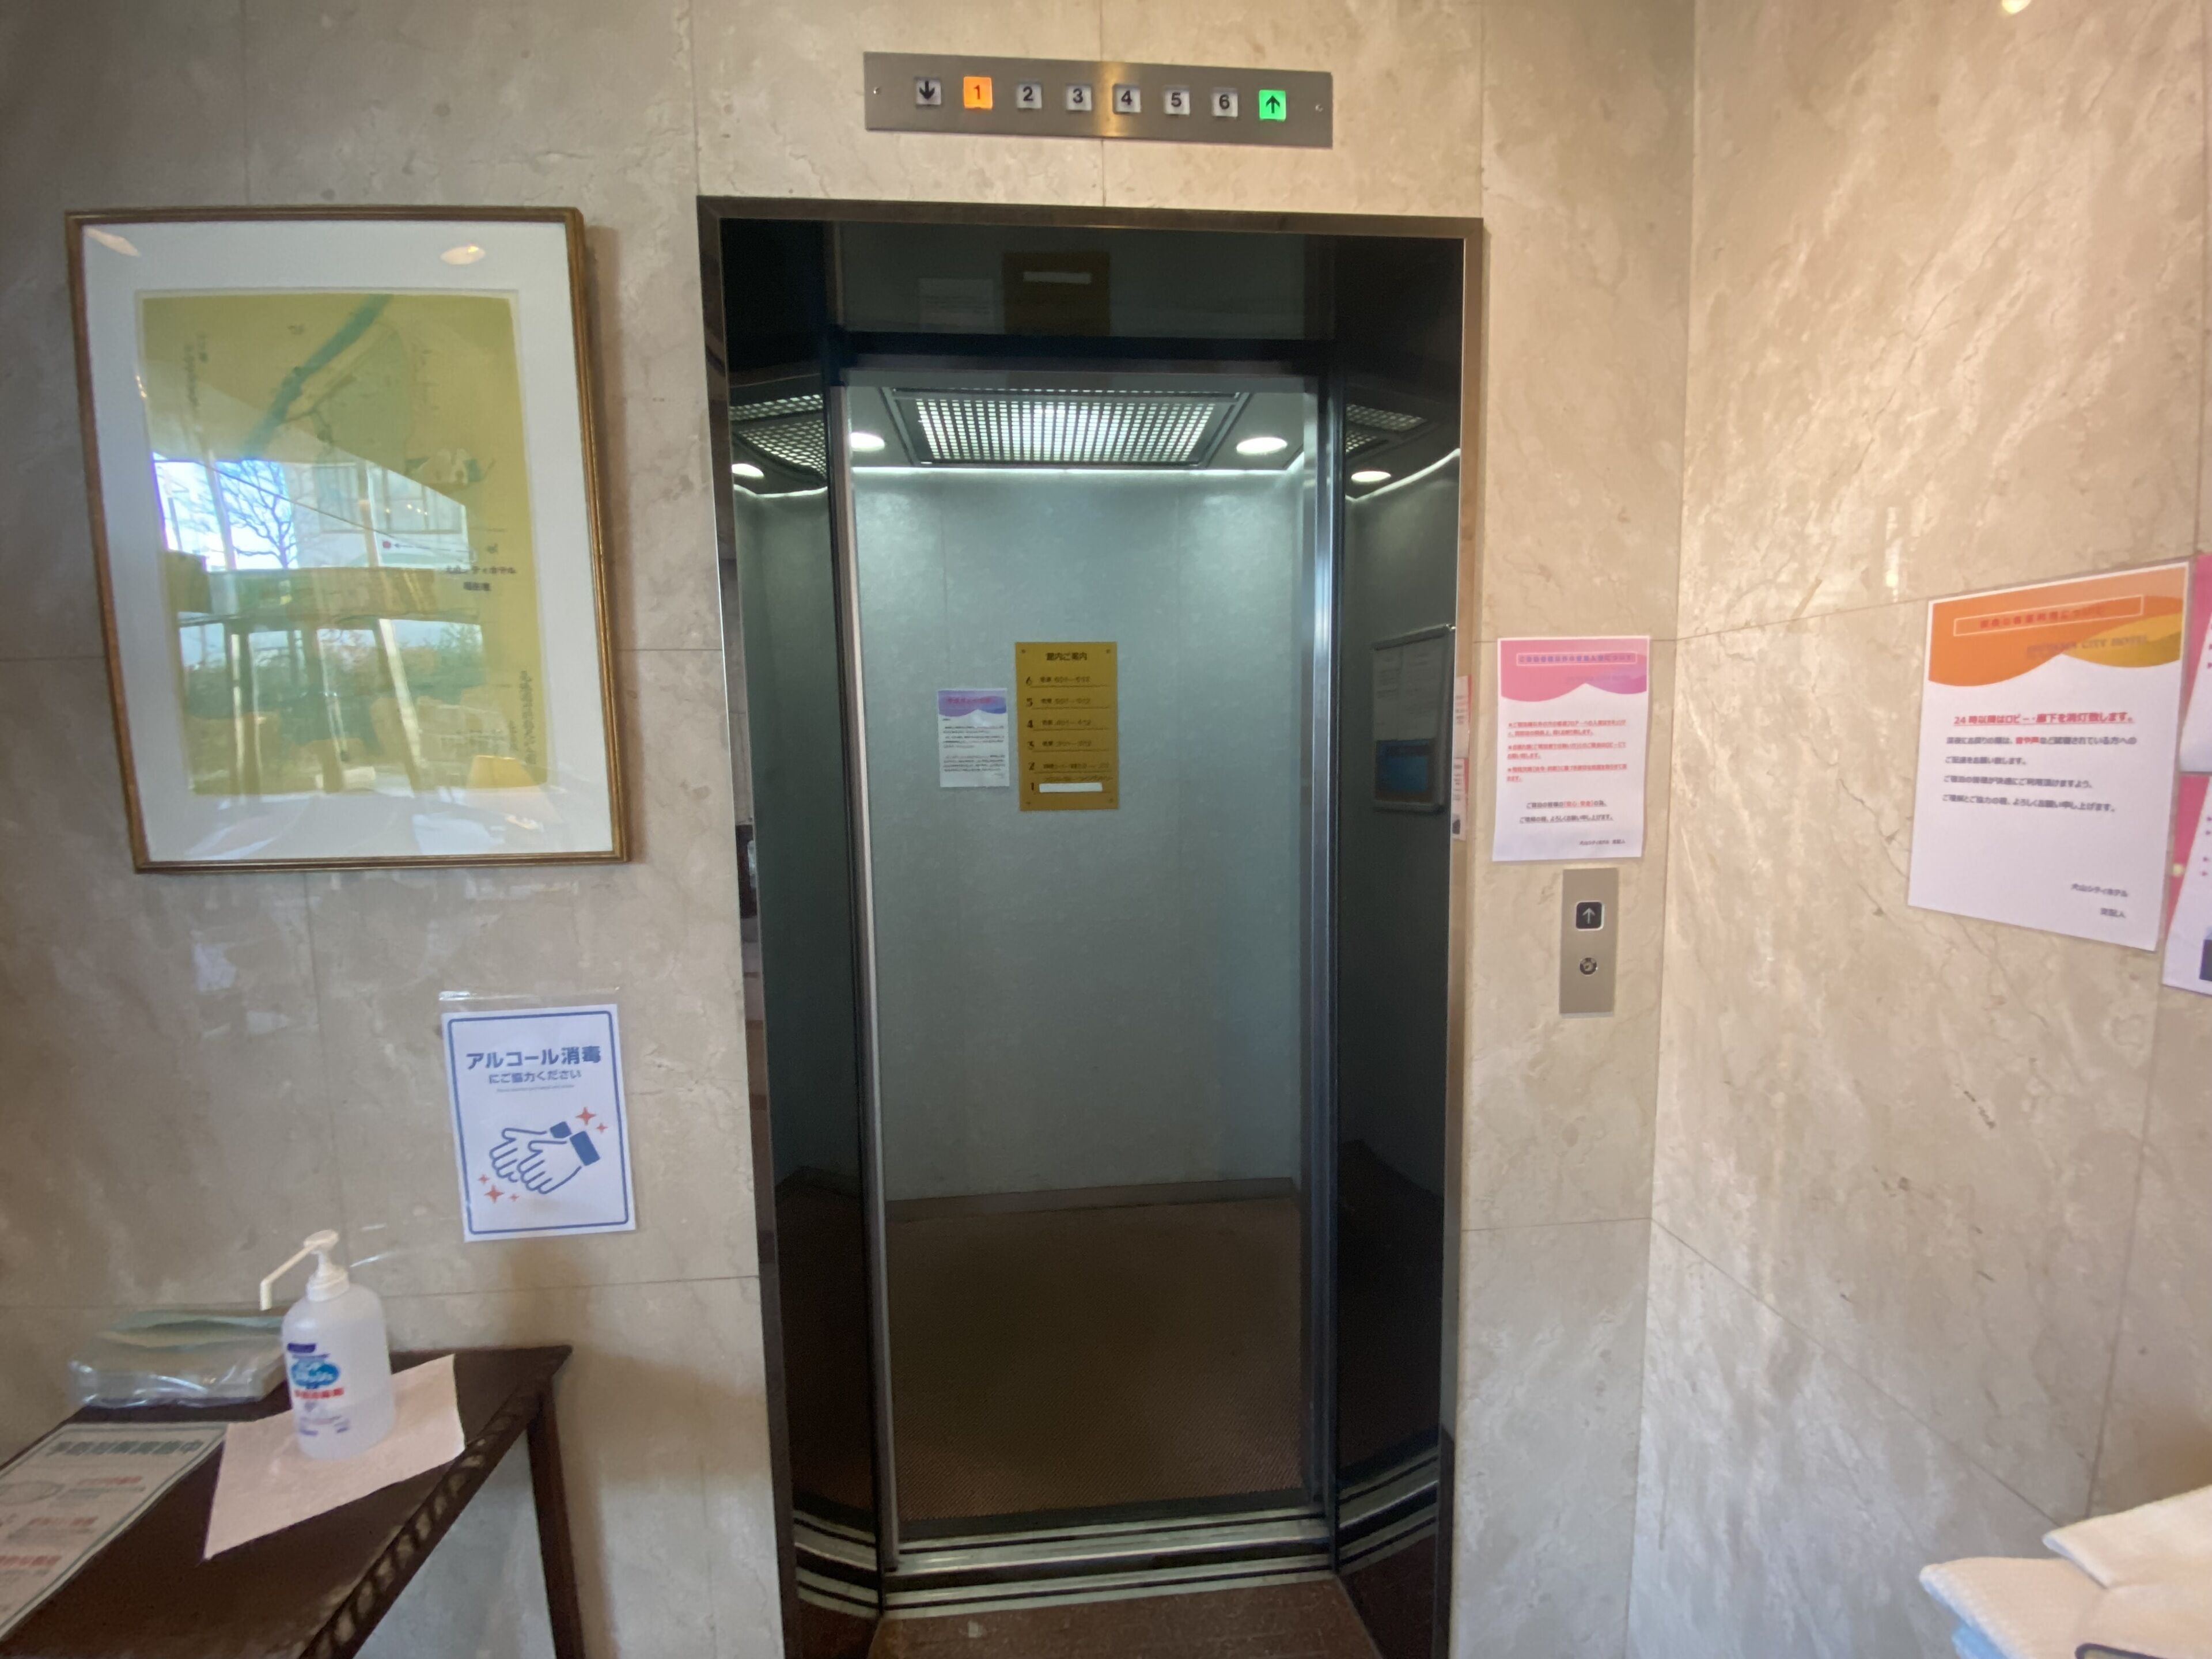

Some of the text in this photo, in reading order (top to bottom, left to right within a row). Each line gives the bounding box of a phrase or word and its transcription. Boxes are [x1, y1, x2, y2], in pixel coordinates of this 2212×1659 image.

[973, 85, 1230, 111] 1 2 3 4 5 6
[1026, 676, 1032, 686] 6
[1027, 698, 1033, 707] 5
[1027, 719, 1033, 728] 4
[466, 1045, 601, 1070] アルコール消毒
[488, 1069, 582, 1085] にご協力ください
